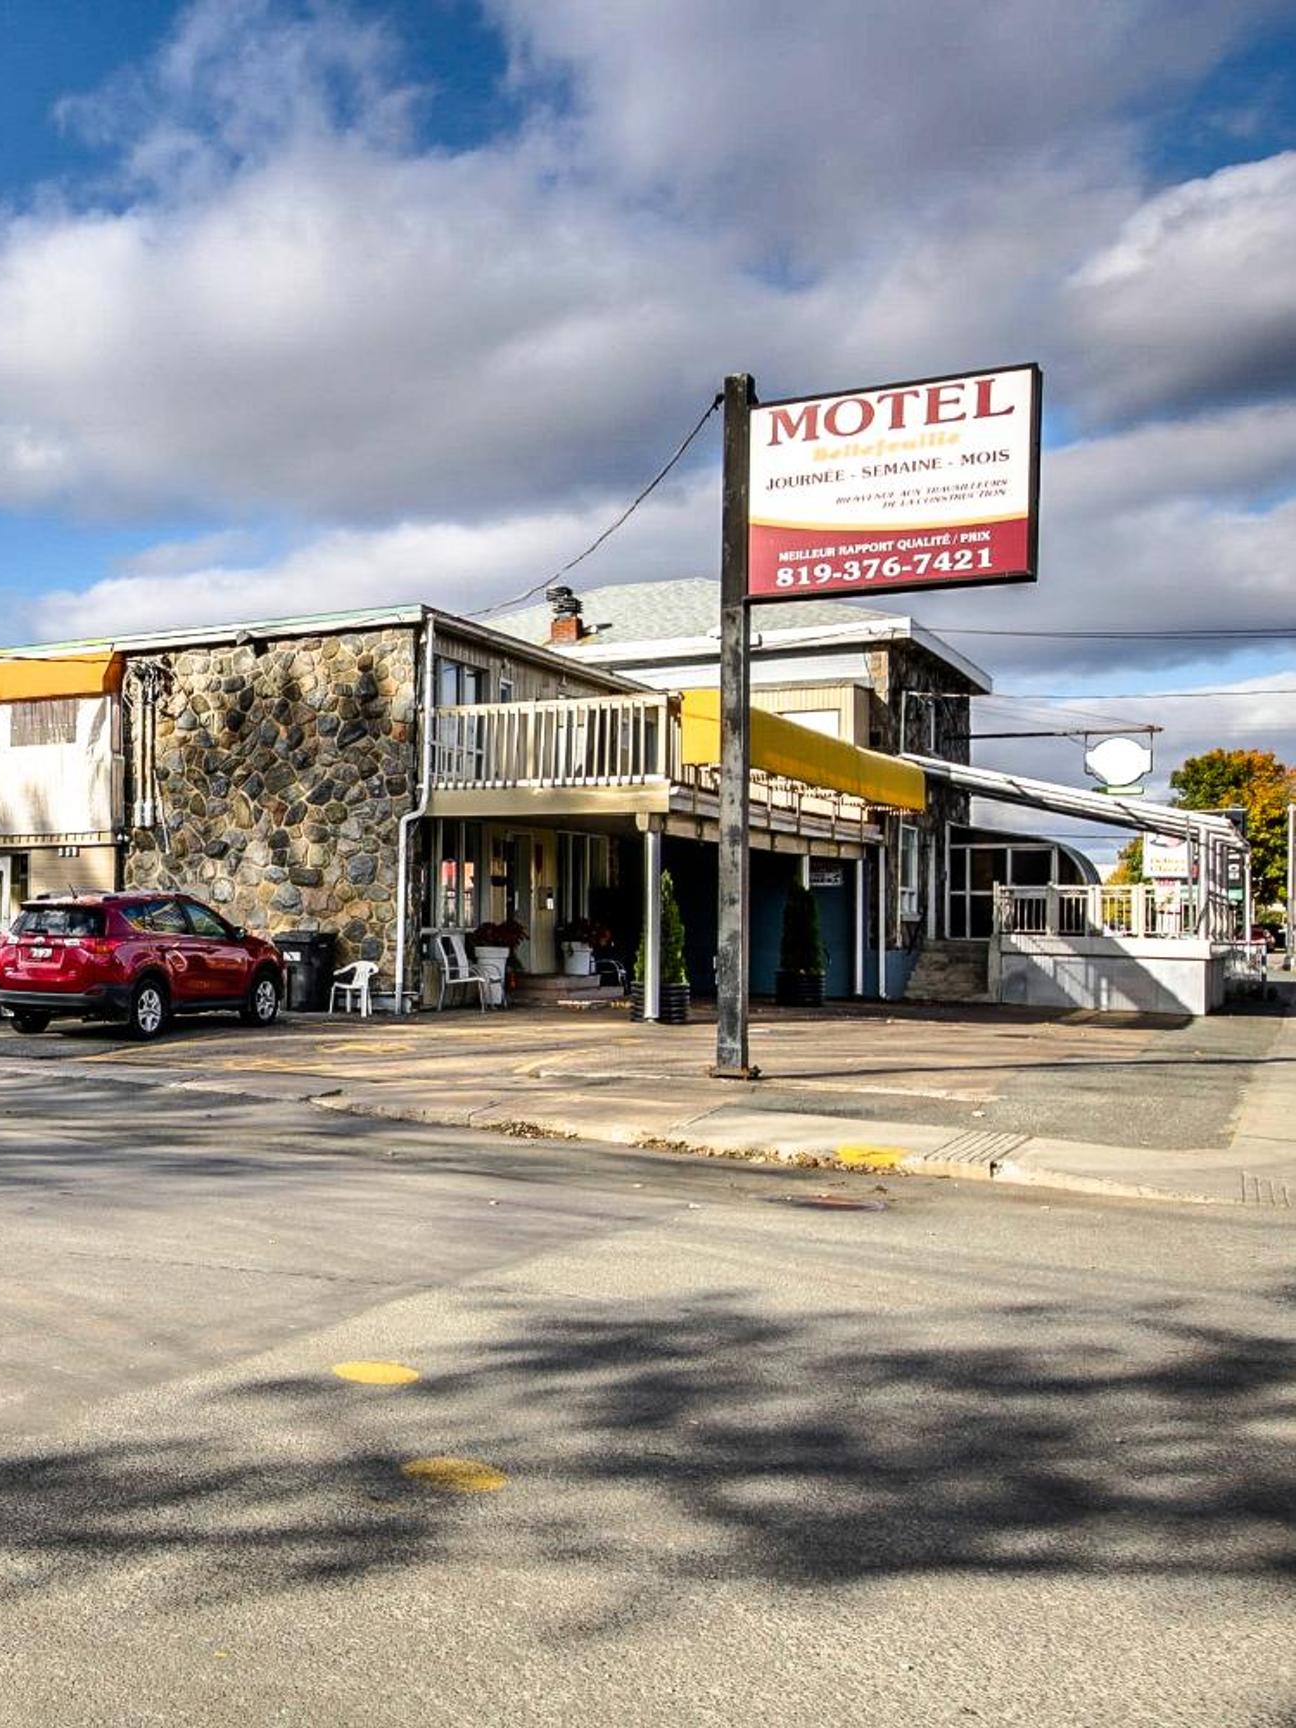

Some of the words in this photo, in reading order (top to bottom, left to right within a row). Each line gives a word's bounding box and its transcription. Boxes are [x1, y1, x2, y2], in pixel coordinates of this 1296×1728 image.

[767, 378, 1015, 446] MOTEL
[766, 469, 845, 491] JOURNÉE
[861, 457, 942, 479] SEMAINE
[959, 449, 1010, 467] MOIS
[778, 547, 836, 562] MEILLEUR
[838, 541, 894, 557] RAPPORT
[896, 533, 950, 551] QUALITÉ
[959, 530, 991, 544] PRIX
[776, 547, 993, 588] 819-376-7421
